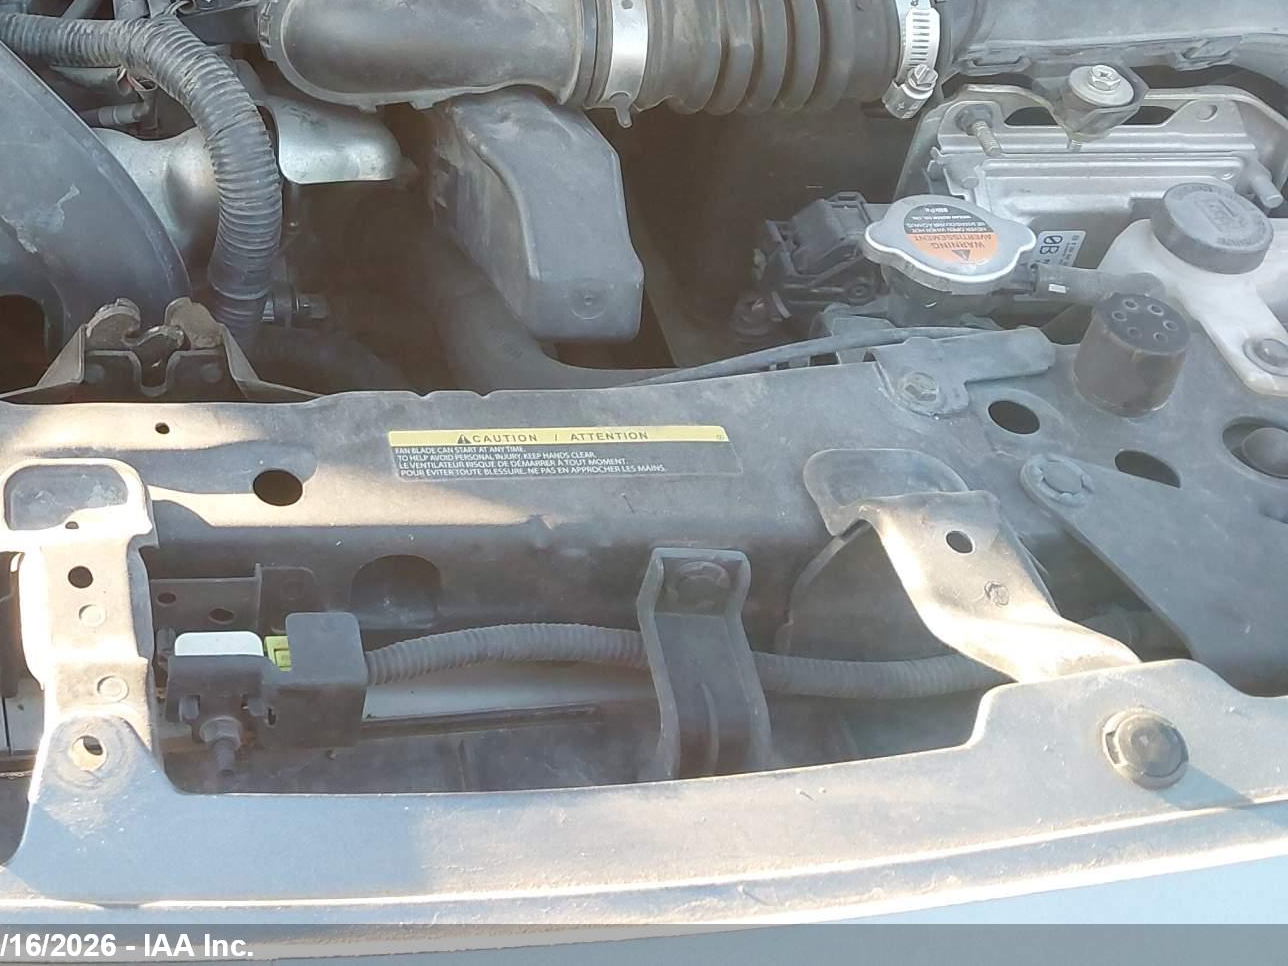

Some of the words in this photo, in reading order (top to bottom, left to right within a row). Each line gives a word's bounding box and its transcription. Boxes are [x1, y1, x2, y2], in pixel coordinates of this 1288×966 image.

[914, 234, 992, 242] AVERTISSEMENT
[930, 241, 985, 250] WARNING
[472, 433, 537, 443] CAUTION
[570, 431, 649, 441] ATTENTION
[411, 446, 436, 454] BLADE
[437, 446, 454, 454] CAN
[397, 454, 408, 462] TO
[409, 454, 429, 462] HELP
[455, 453, 494, 461] PERSONAL
[523, 452, 542, 460] KEEP
[542, 451, 570, 459] HANDS
[409, 461, 465, 469] VENTILATEUR
[466, 461, 496, 469] RISQUE
[510, 458, 556, 467] DÉMARRER
[564, 458, 586, 466] TOUT
[588, 458, 629, 466] MOMENT.
[400, 469, 425, 477] POUR
[456, 468, 482, 476] TOUTE
[528, 467, 540, 475] NE
[556, 466, 569, 474] EN
[570, 465, 621, 474] APPROCHER
